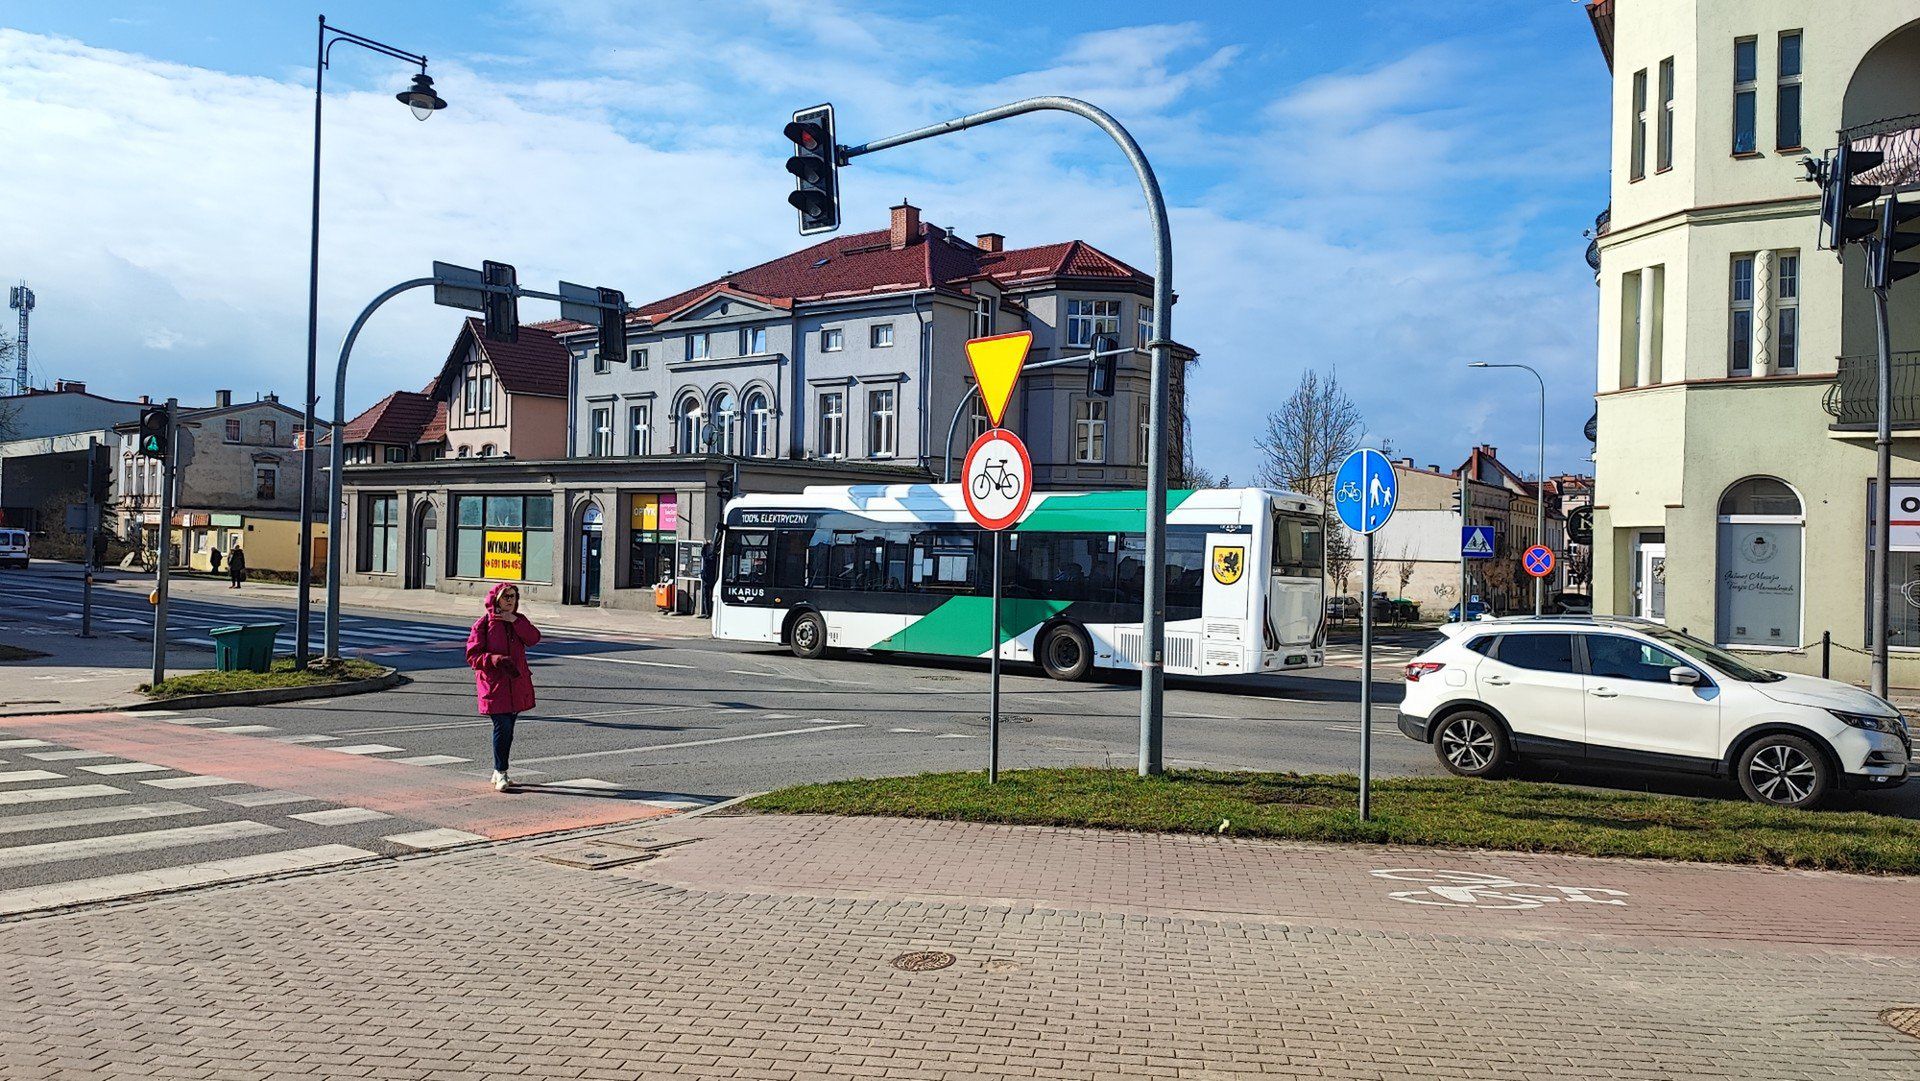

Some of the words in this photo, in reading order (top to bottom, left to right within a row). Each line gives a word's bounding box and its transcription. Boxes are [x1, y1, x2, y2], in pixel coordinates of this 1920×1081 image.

[742, 514, 759, 523] 100%
[761, 514, 808, 523] ELEKTRYCZNY
[487, 541, 521, 556] WYNAJMĘ
[728, 587, 764, 597] IKARUS
